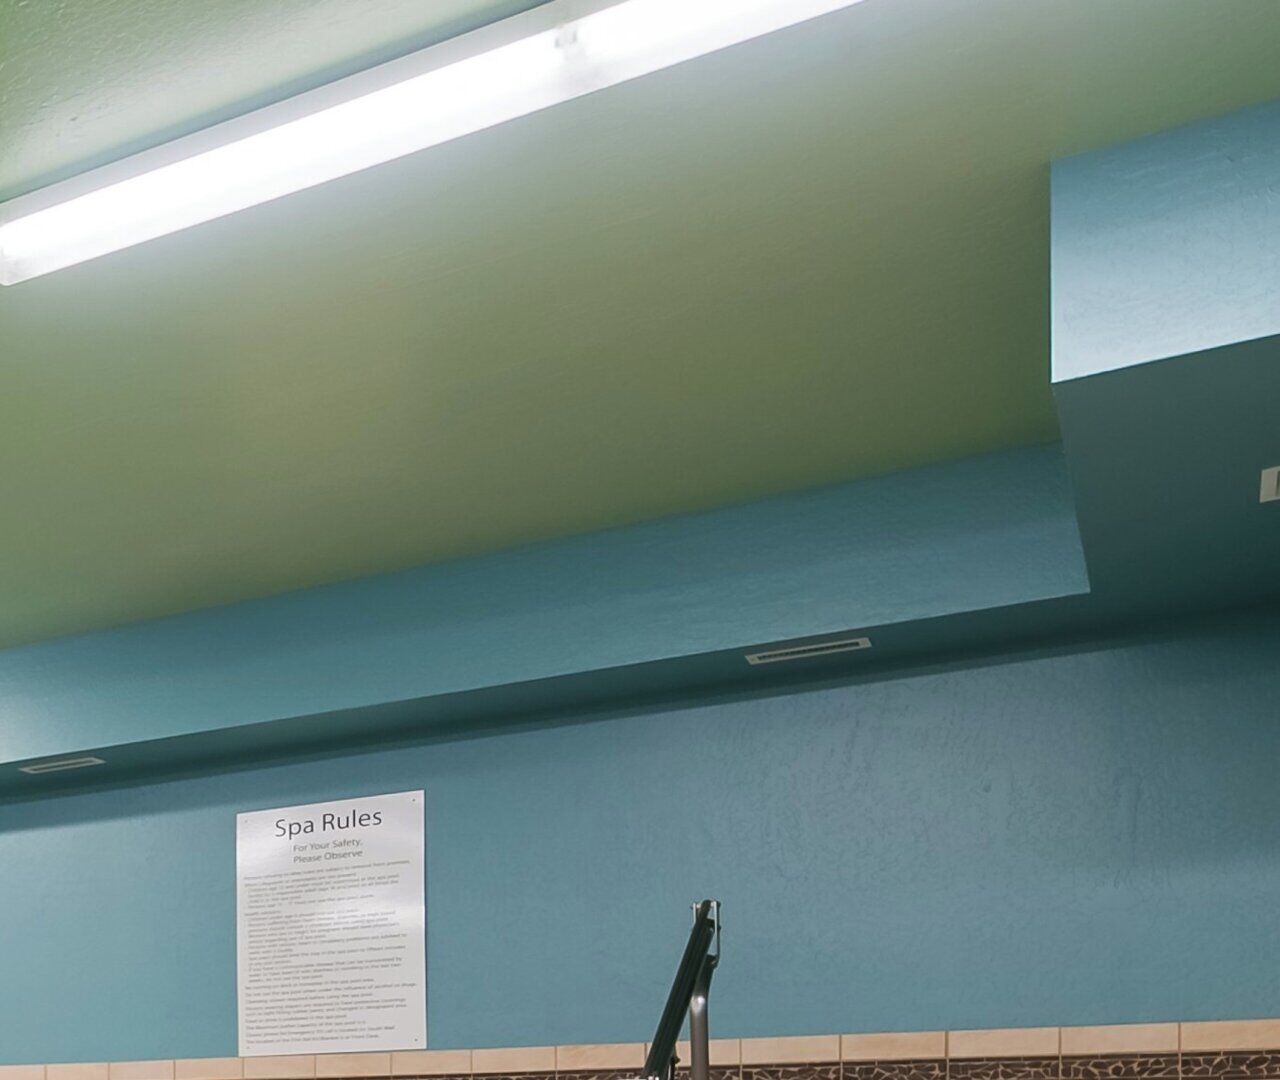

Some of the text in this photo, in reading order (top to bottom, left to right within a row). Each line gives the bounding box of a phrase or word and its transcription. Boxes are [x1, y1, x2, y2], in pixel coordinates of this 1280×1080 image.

[275, 809, 382, 840] Spa Rules
[310, 843, 330, 851] Your
[293, 850, 363, 863] Please Observe
